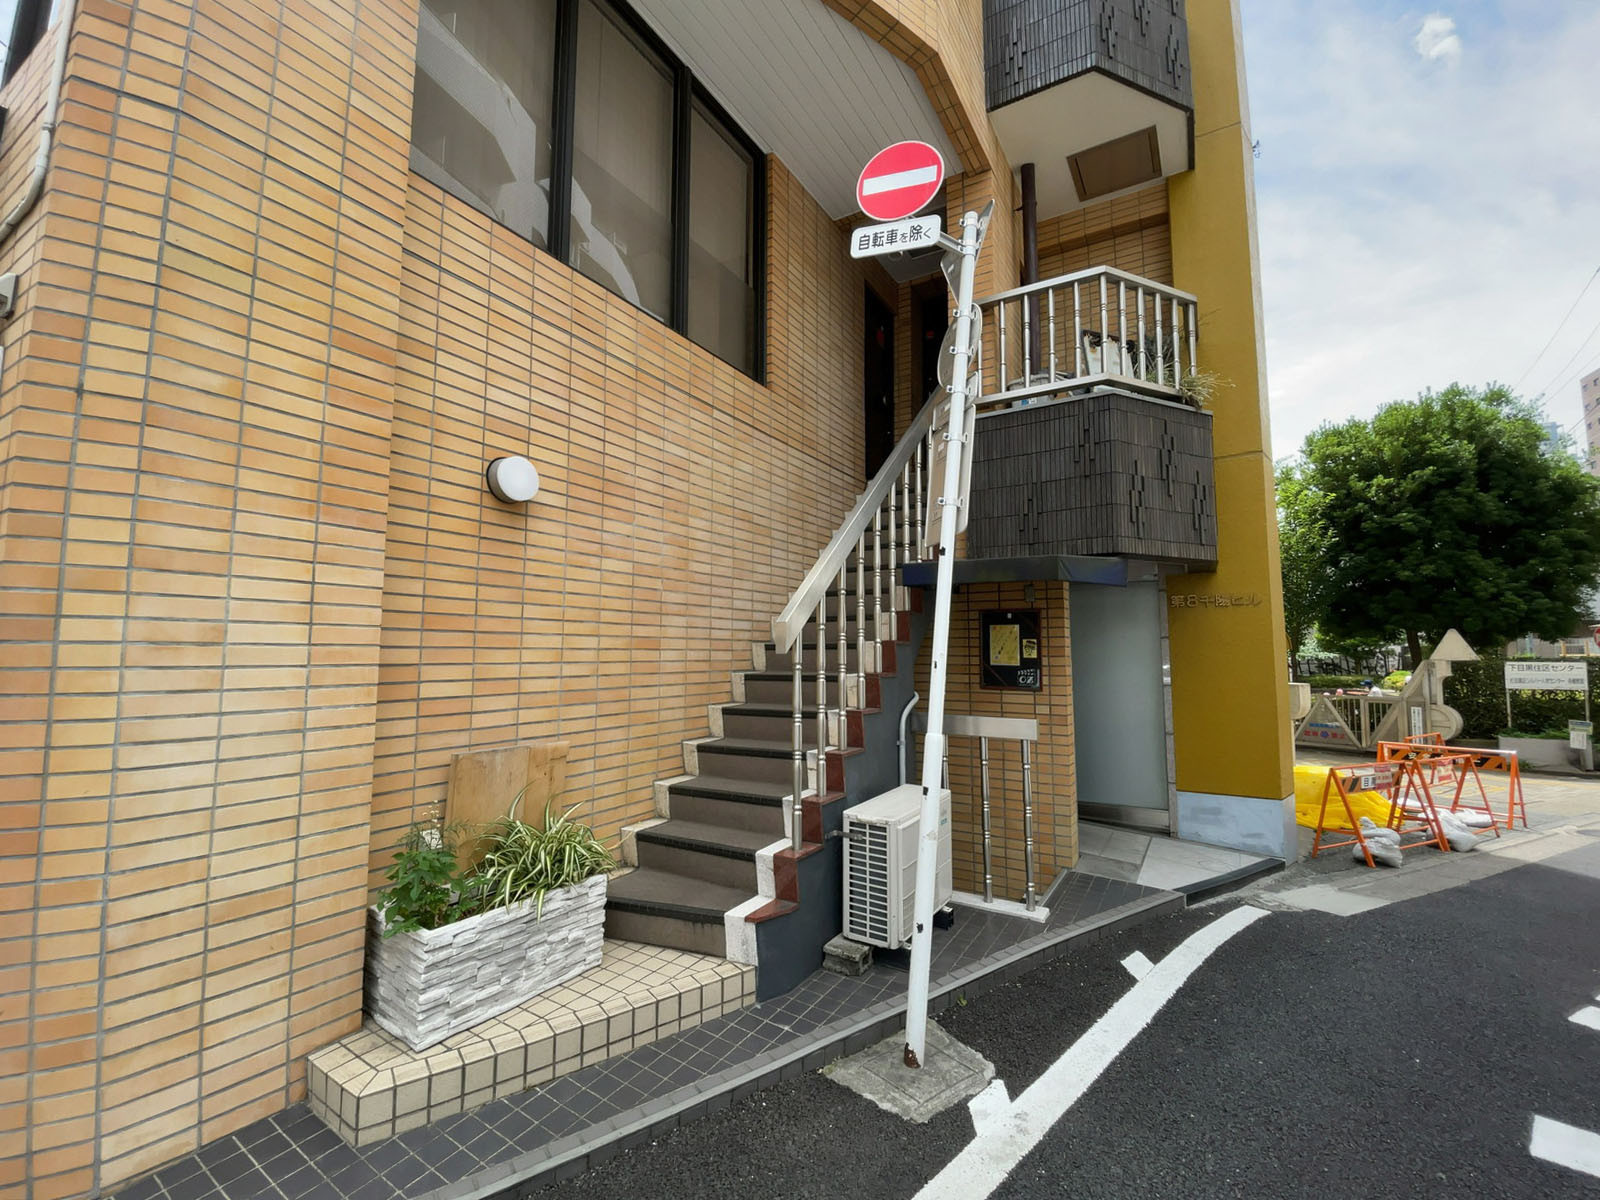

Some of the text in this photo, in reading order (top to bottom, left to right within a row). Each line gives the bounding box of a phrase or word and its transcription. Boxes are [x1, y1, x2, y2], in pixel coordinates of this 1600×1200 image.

[858, 224, 932, 251] 自転車を除く
